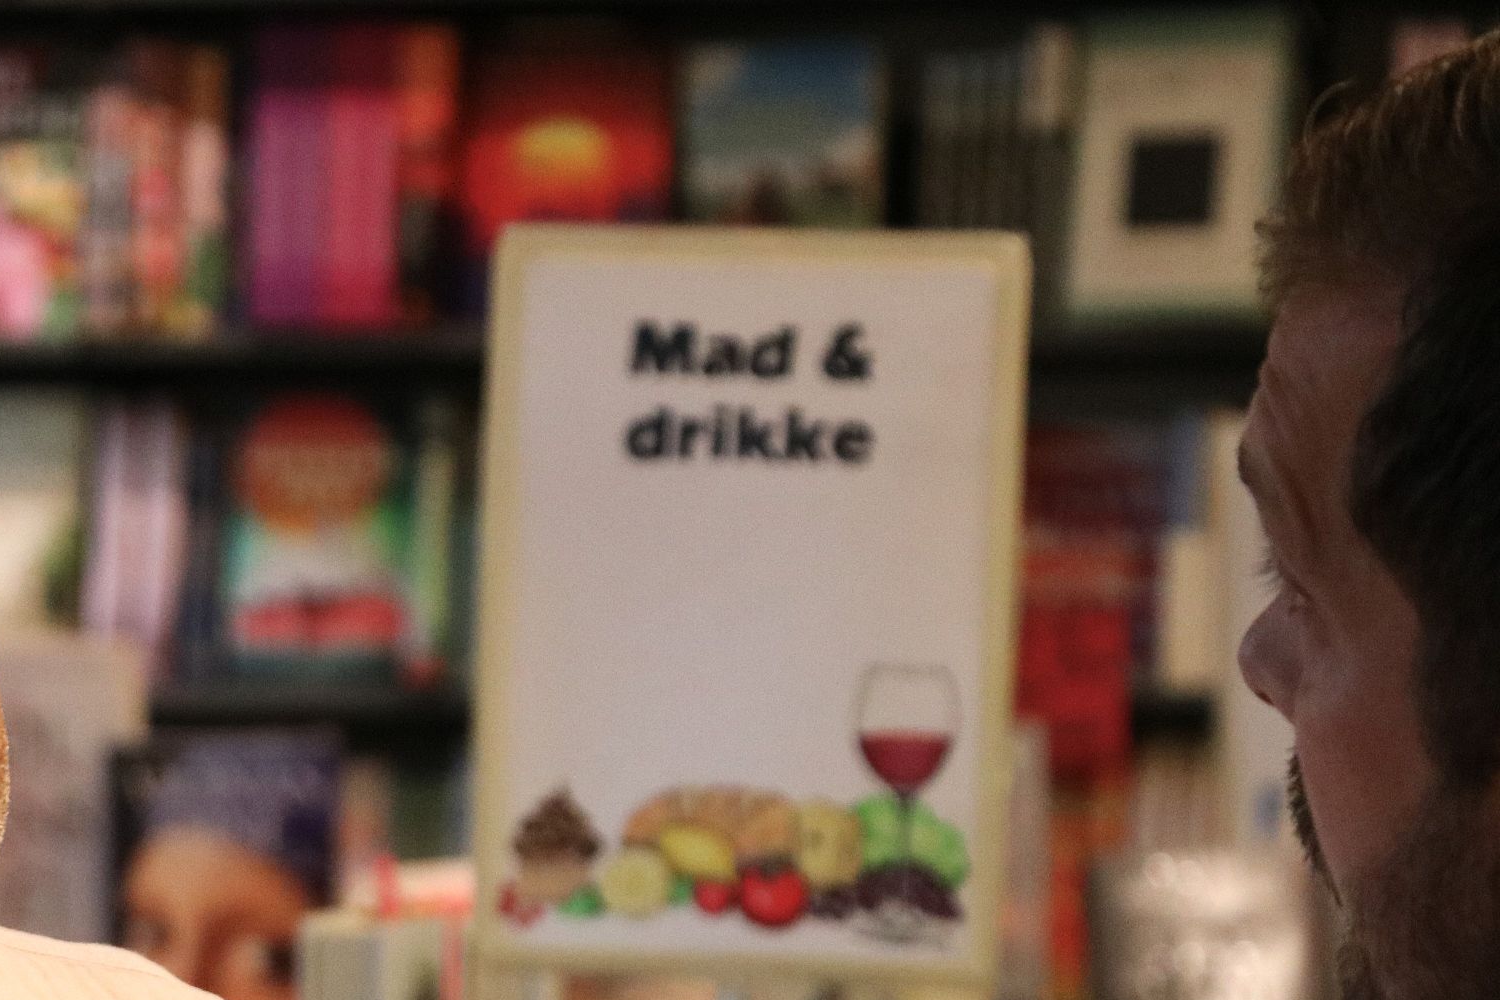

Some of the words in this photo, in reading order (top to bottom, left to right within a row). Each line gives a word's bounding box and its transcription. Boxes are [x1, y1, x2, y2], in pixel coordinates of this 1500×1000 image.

[630, 320, 796, 379] Mad
[822, 323, 873, 380] &
[626, 405, 874, 461] drikke
